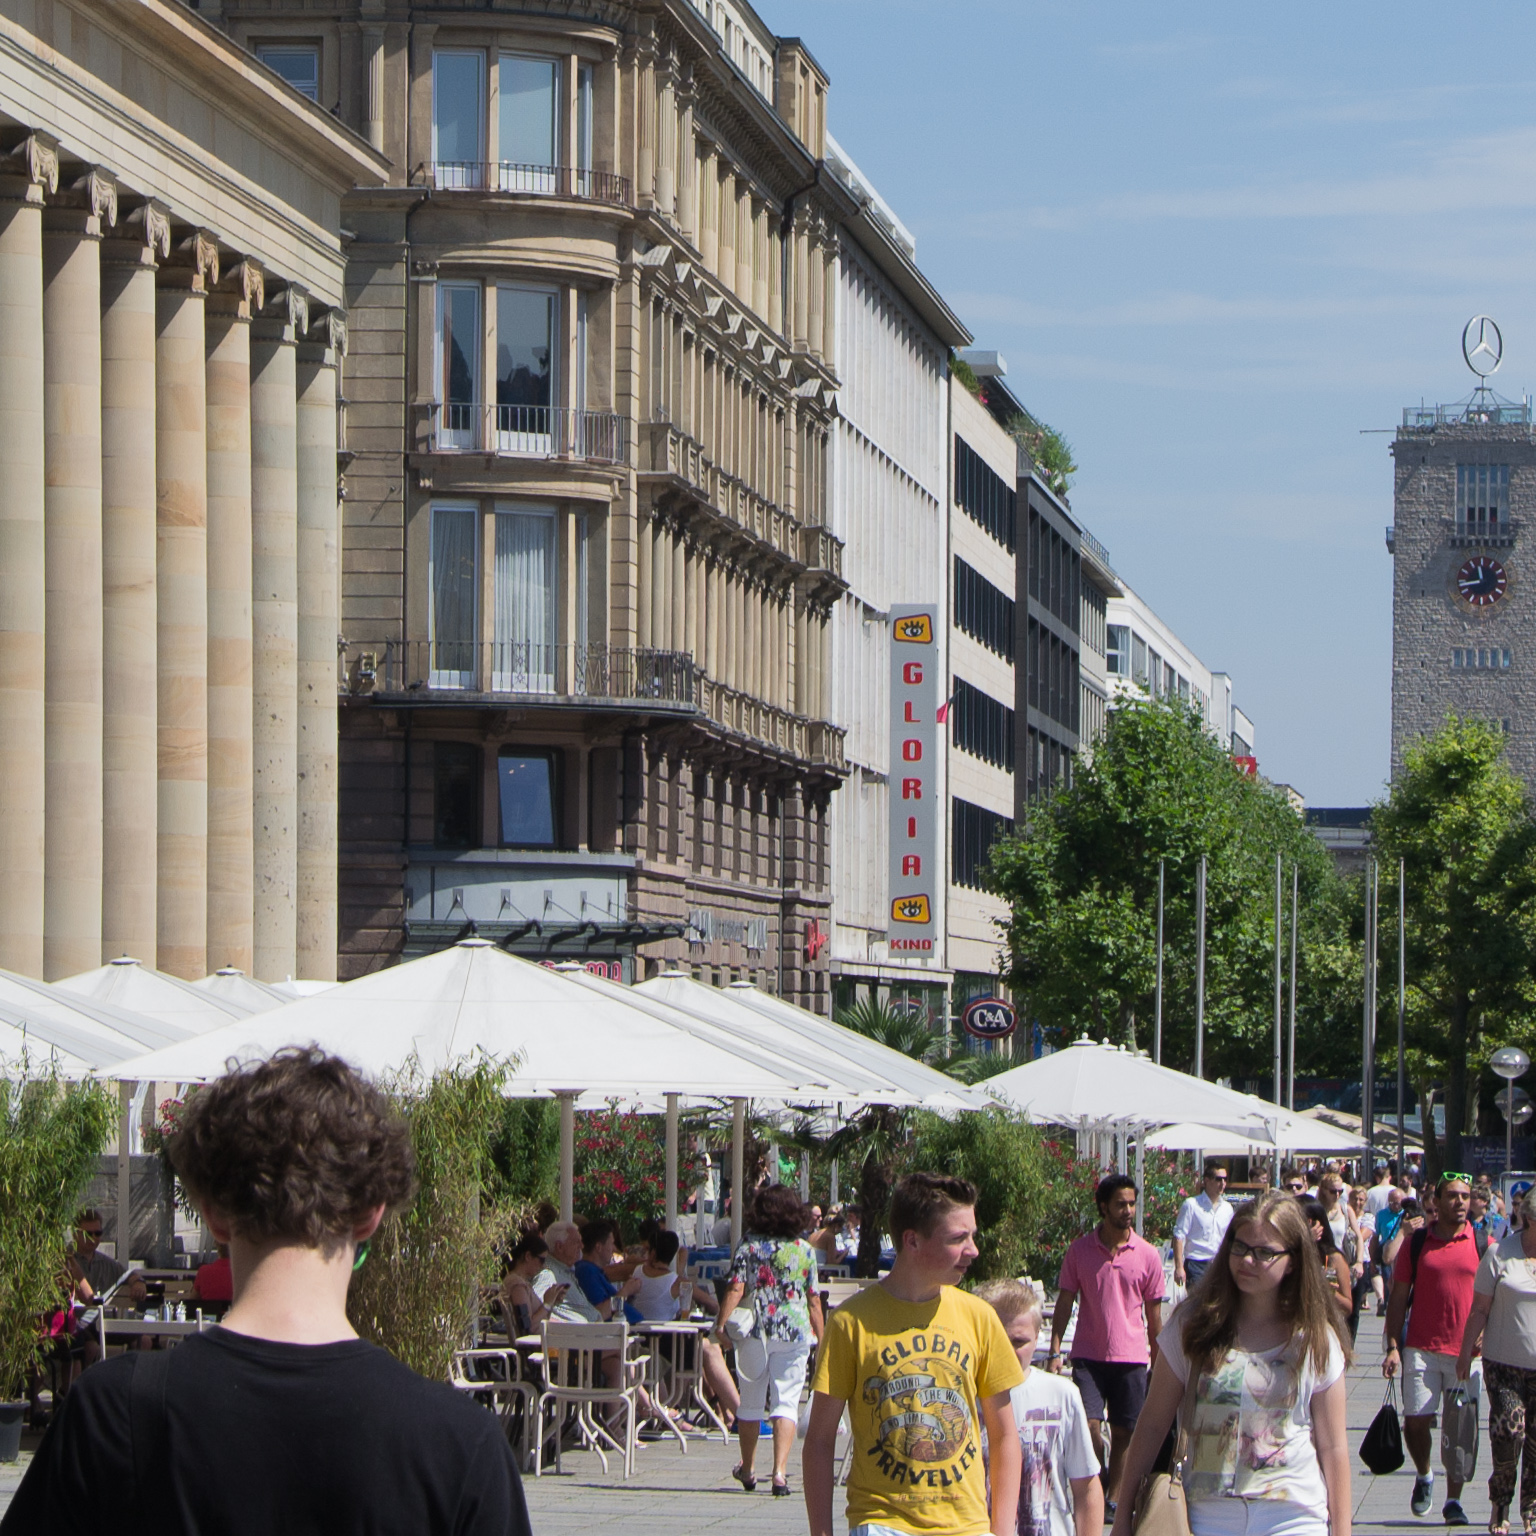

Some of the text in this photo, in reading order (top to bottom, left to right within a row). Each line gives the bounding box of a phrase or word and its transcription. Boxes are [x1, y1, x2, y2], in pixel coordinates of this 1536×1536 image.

[901, 661, 924, 877] GLORIA
[890, 939, 932, 951] KINO
[973, 1008, 1008, 1028] C&A
[881, 1334, 972, 1373] GLOBAL
[881, 1377, 920, 1397] AROUND
[924, 1389, 941, 1401] THE
[867, 1438, 977, 1487] TRAVELLER
